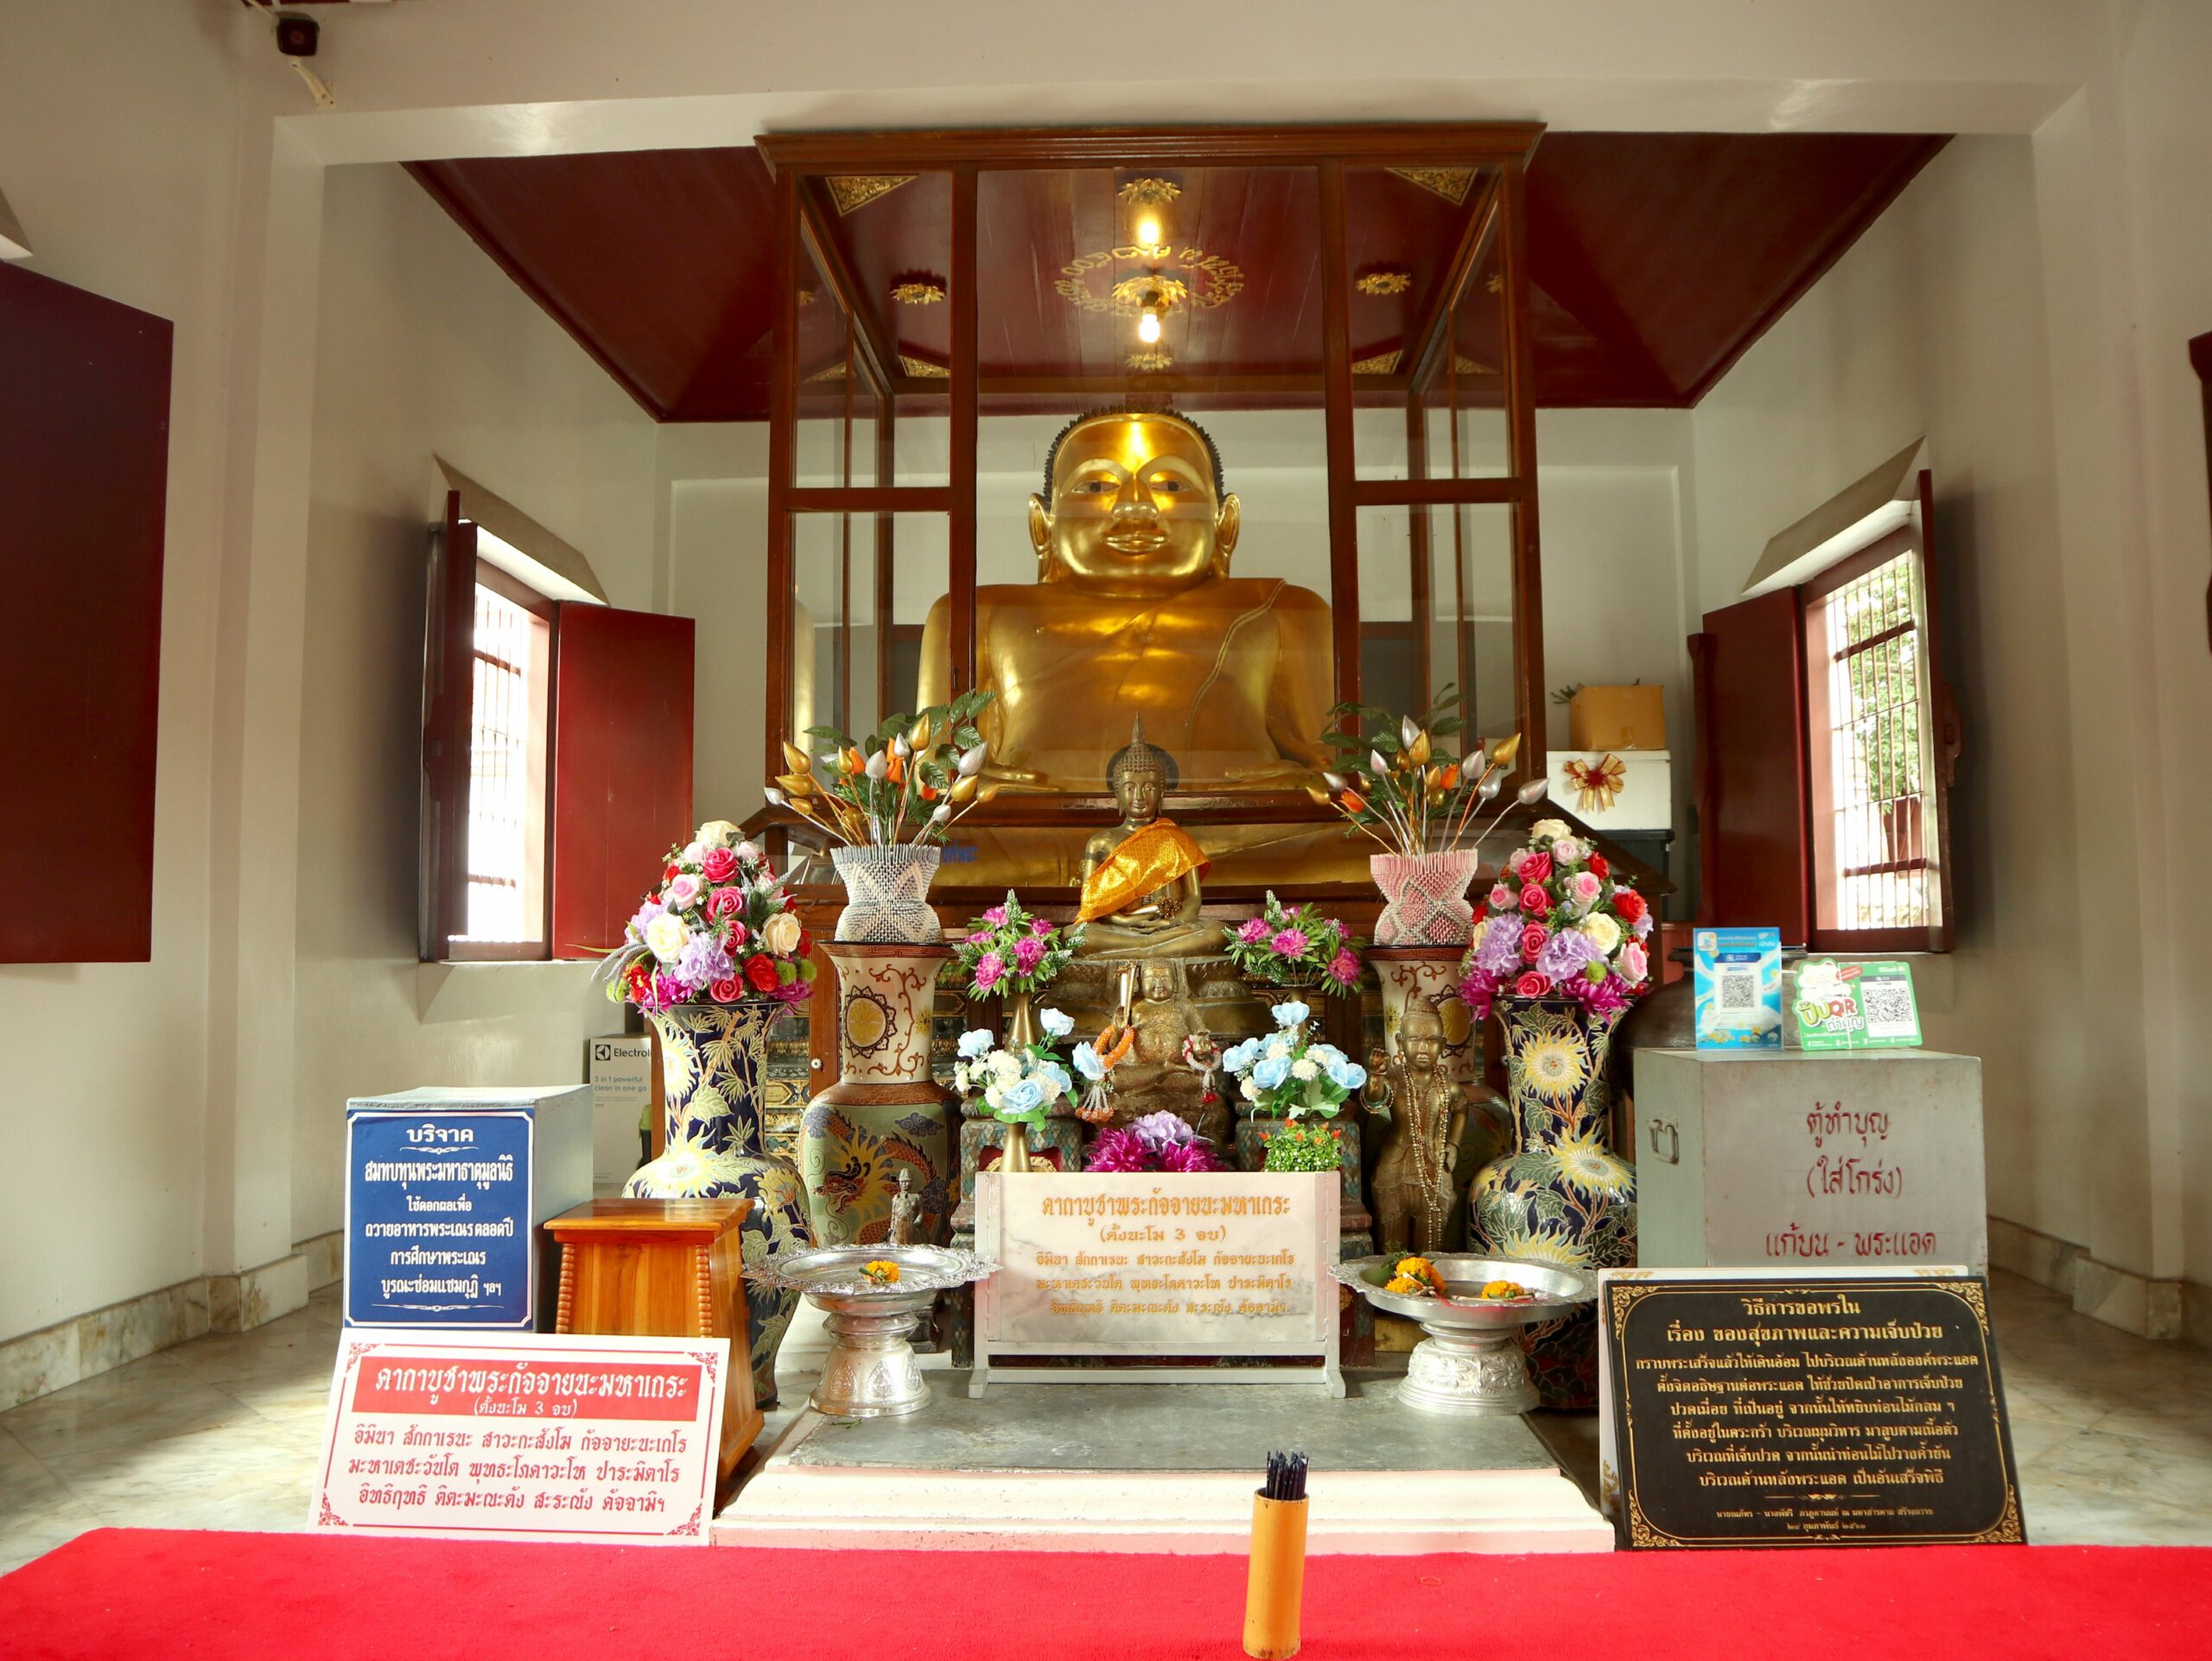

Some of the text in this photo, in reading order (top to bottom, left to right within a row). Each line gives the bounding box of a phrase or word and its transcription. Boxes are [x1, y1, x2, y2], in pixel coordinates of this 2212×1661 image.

[407, 1123, 473, 1142] บริจาค
[1807, 1102, 1888, 1148] ตู้ทำบุญ
[365, 1155, 512, 1190] สมทบทุนพระมหาธาตุมูลนิธิ
[406, 1193, 472, 1211] ใช้ดอกผลเพื่อ
[1174, 1228, 1186, 1242] 3
[1766, 1222, 1829, 1258] แก้บน
[1854, 1231, 1936, 1257] พระแอด
[391, 1245, 486, 1264] การศึกษาพระเณร
[484, 1283, 501, 1295] ฯลฯ
[1741, 1295, 1861, 1316] วิธีการขอพรใน
[1668, 1319, 1942, 1346] เรื่อง ของสุขภาพและความเจ็บป่วย
[536, 1402, 543, 1414] 3
[1670, 1397, 1727, 1415] ปวดเมื่อย
[1733, 1397, 1783, 1419] ที่เป็นอยู่
[355, 1423, 395, 1445] อิมินา
[403, 1424, 471, 1448] สักกาเรนะ
[1777, 1423, 1860, 1441] บริเวณมุมวิหาร
[1866, 1418, 1959, 1440] มาลูบตามเนื้อตัว
[1687, 1444, 1780, 1462] บริเวณที่เจ็บปวด
[596, 1458, 679, 1483] ปาระมิตาโร
[1700, 1468, 1943, 1486] บริเวณด้านหลังพระแอด เป็นอันเสร็จพิธี
[533, 1488, 594, 1511] สะระณัง
